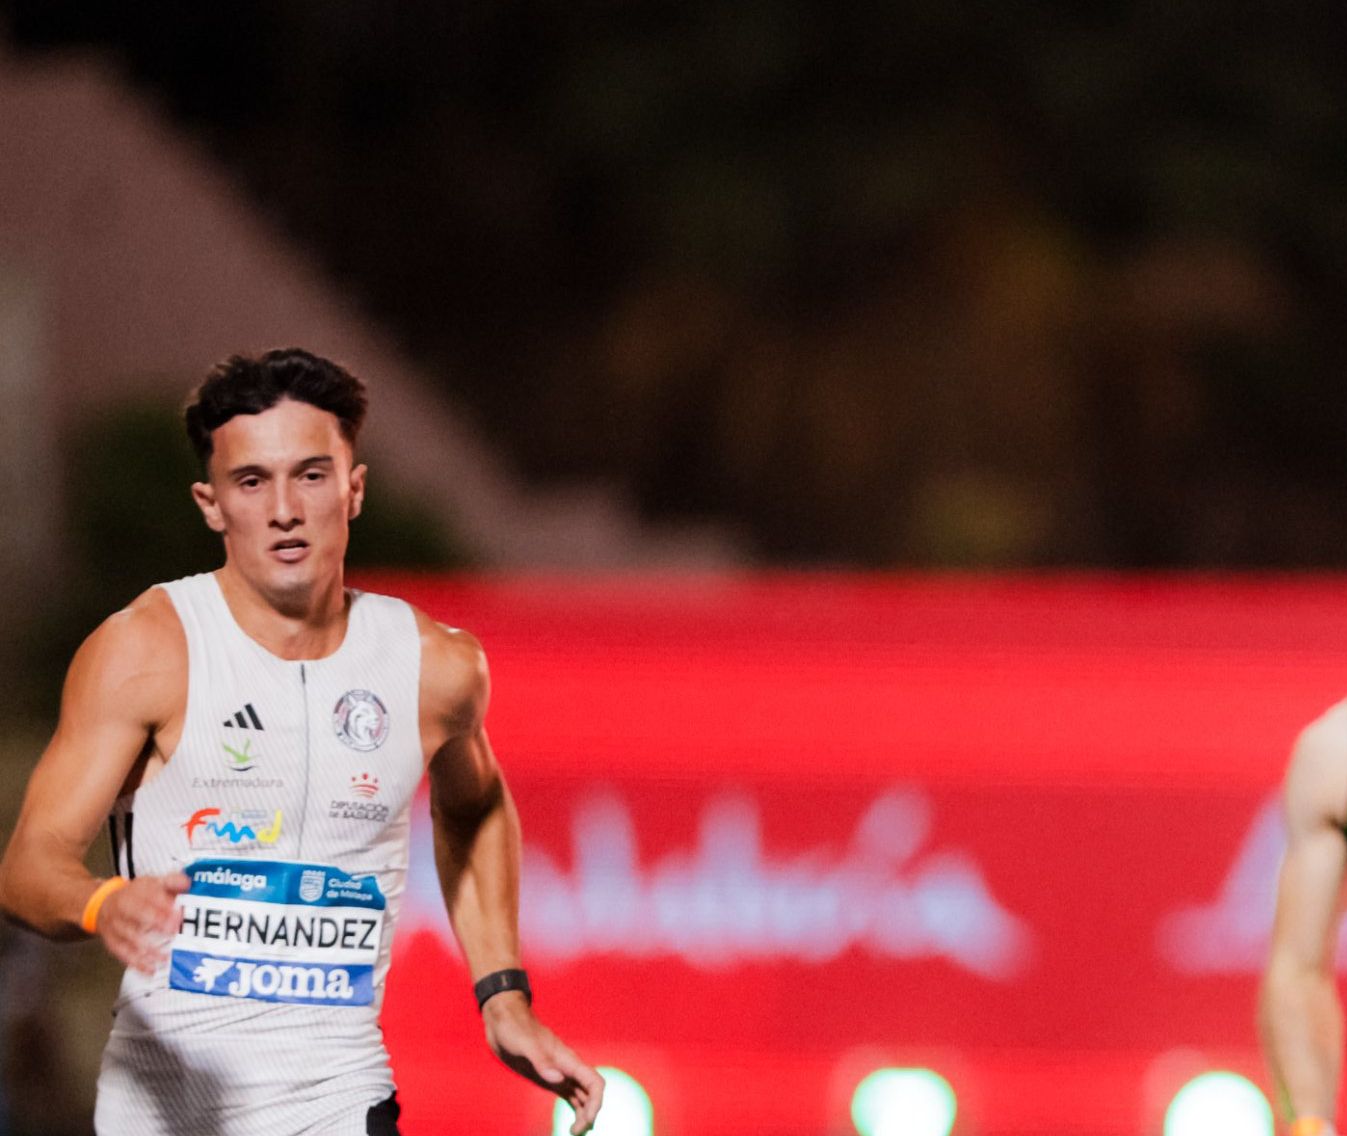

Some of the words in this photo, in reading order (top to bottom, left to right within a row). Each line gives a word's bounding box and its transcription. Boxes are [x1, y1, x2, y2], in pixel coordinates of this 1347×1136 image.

[192, 777, 284, 788] Extremadura
[194, 867, 267, 890] málaga
[179, 906, 377, 951] HERNANDEZ
